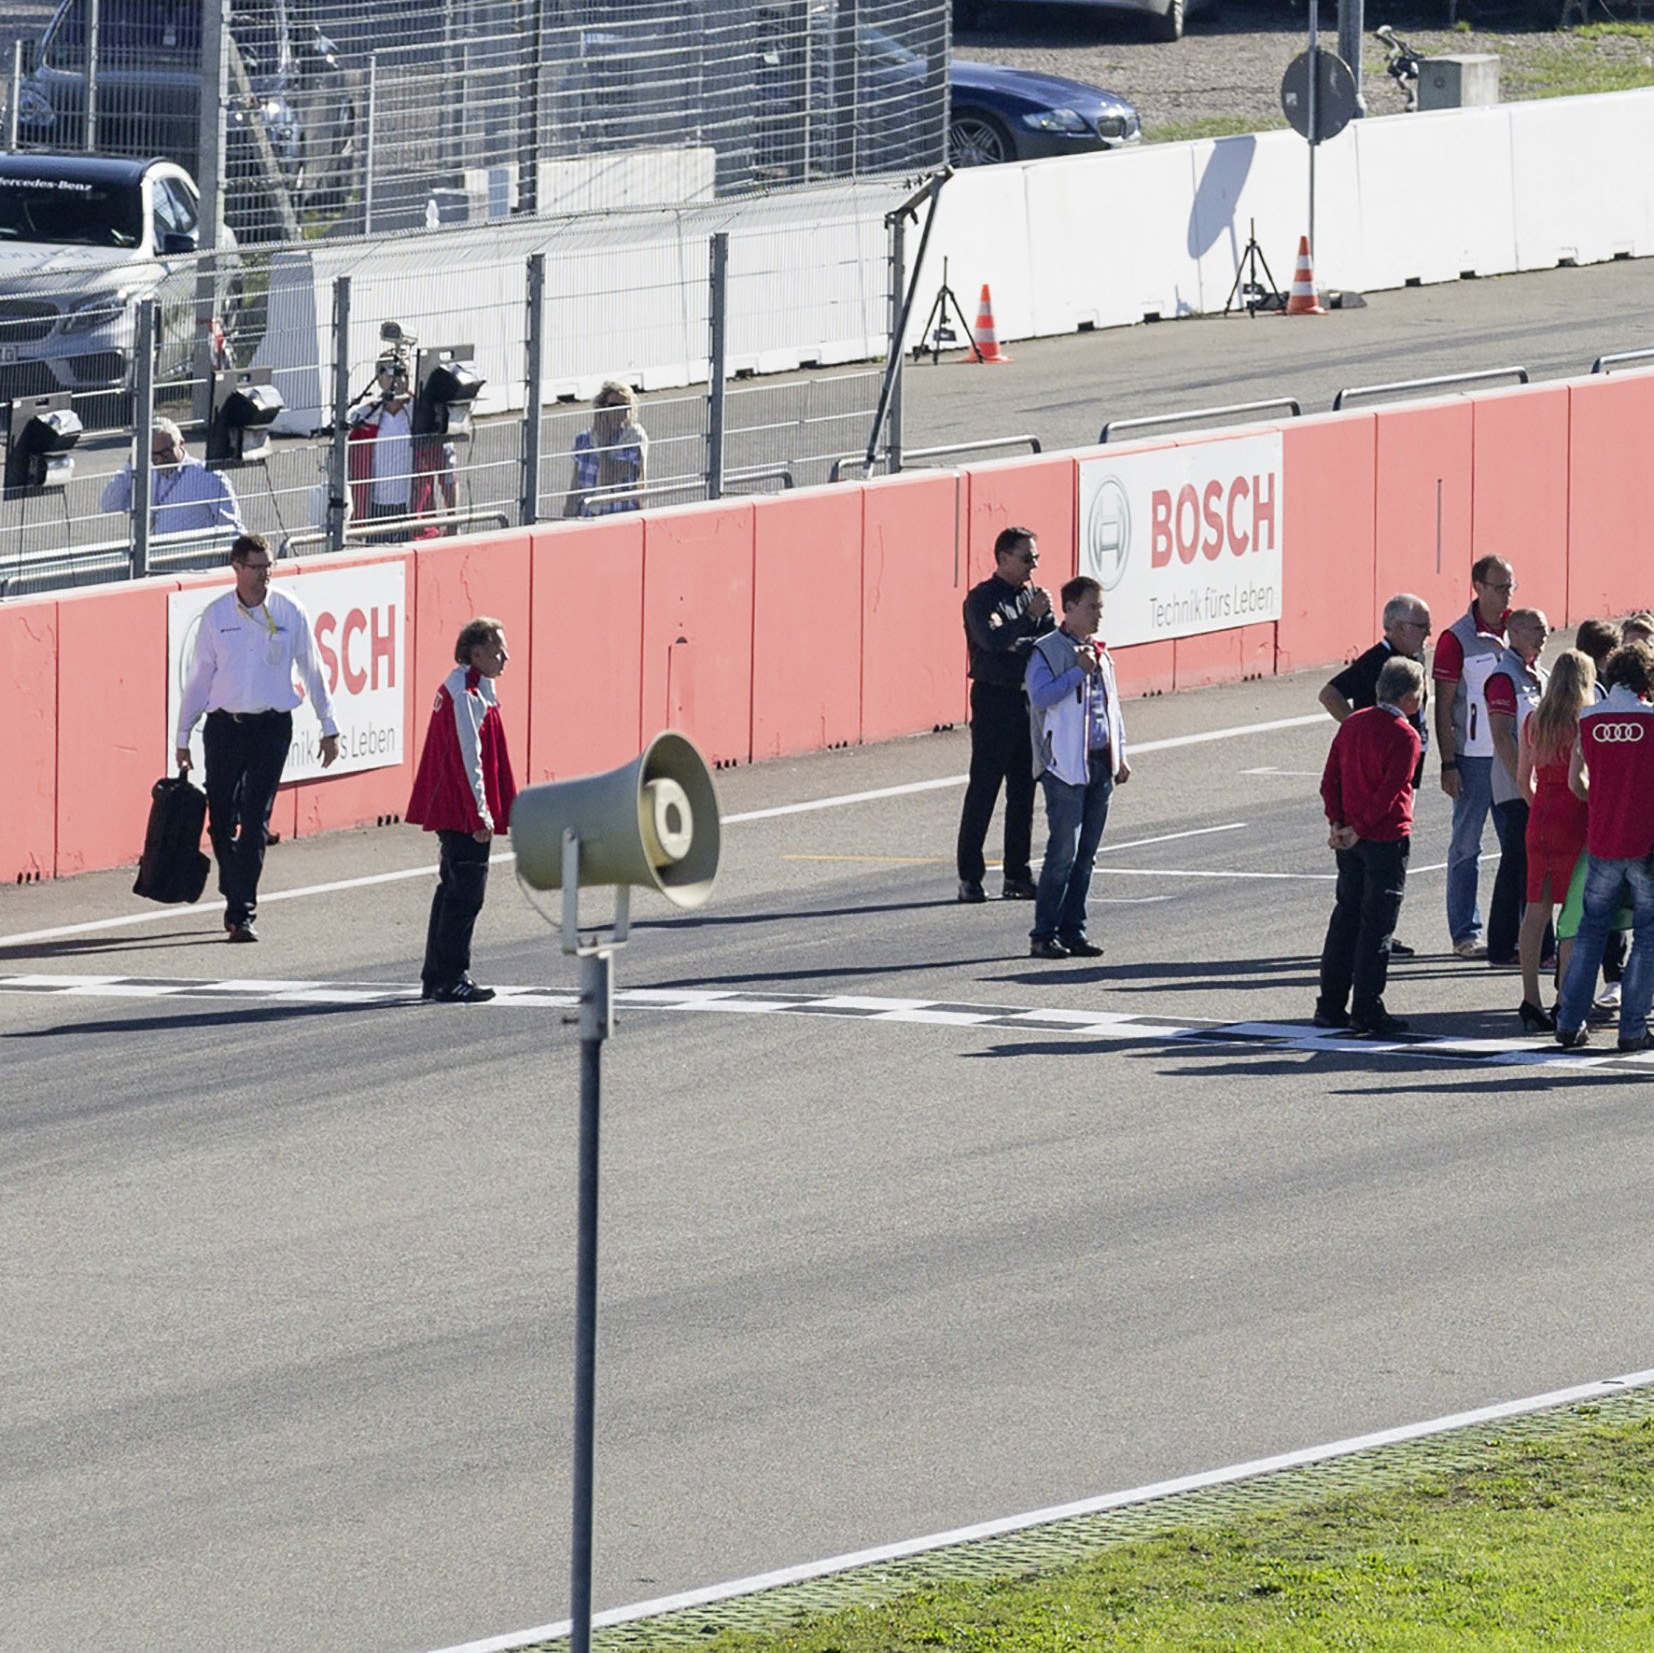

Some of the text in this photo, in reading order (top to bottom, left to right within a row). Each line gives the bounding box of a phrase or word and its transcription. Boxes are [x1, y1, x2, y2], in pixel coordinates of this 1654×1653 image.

[1151, 473, 1275, 568] BOSCH
[1149, 579, 1274, 628] Technik fürs Leben
[296, 604, 396, 699] SCH
[351, 721, 396, 758] Leben
